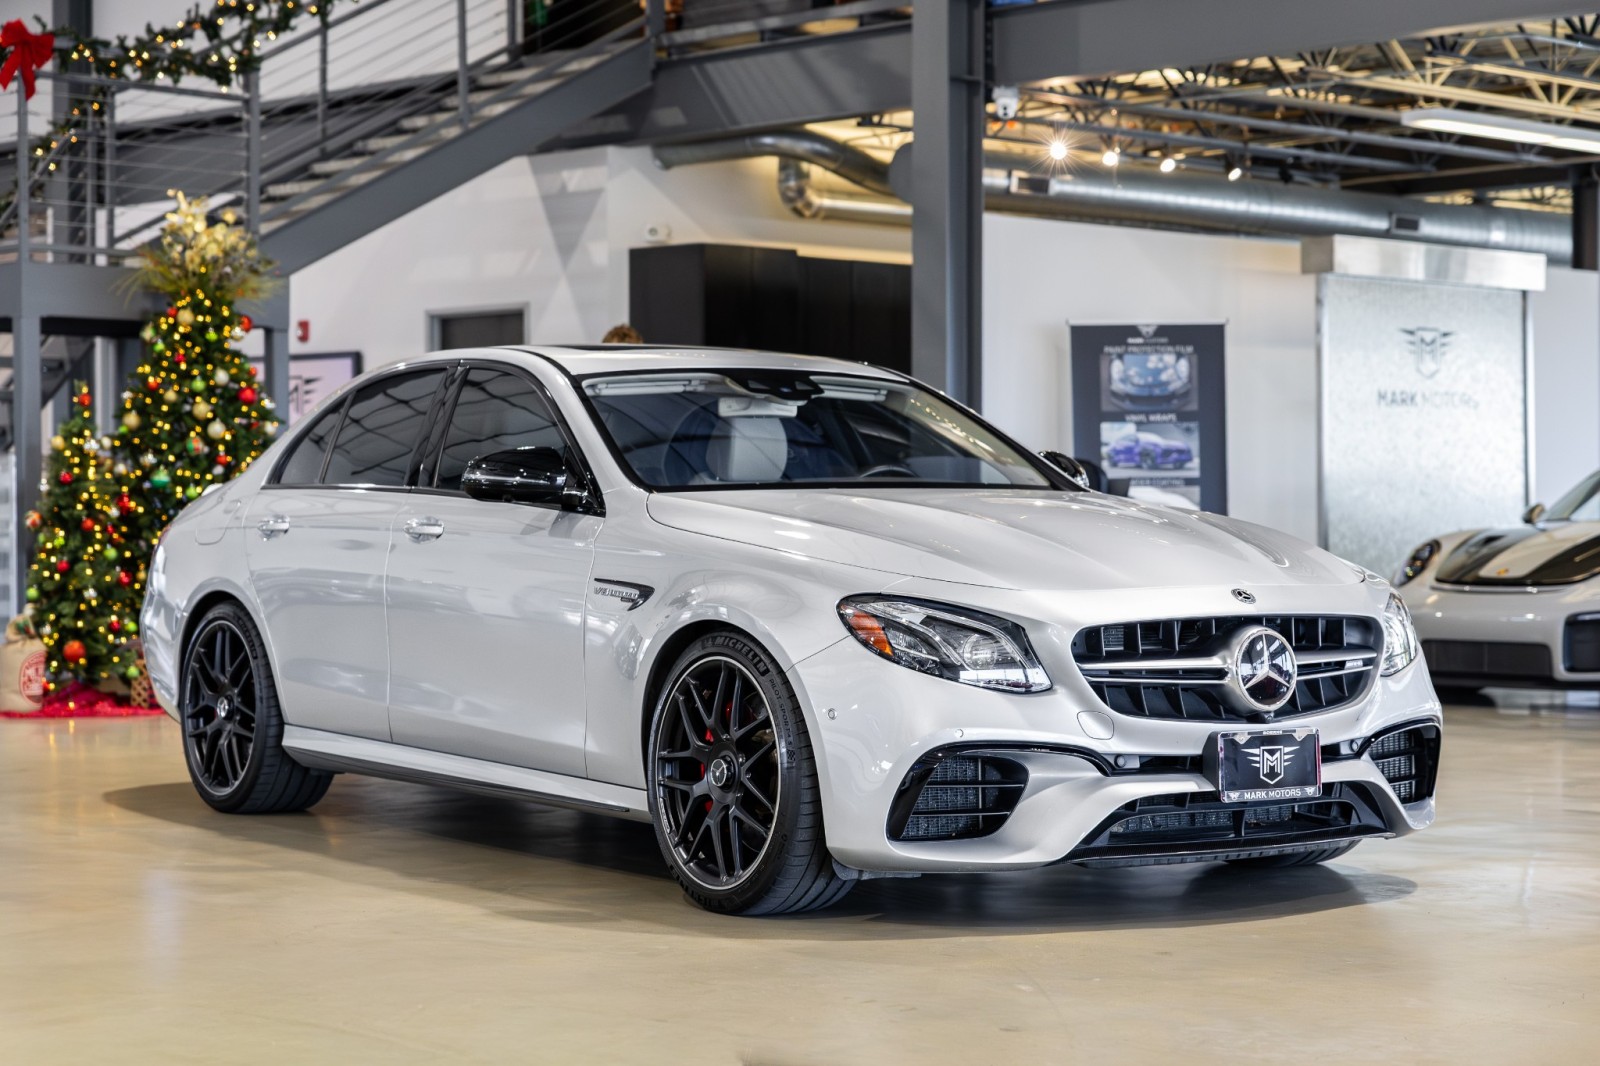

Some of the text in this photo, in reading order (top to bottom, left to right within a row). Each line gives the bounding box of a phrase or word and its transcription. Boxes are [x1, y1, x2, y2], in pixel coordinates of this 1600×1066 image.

[1377, 390, 1479, 410] MARK MOTORS
[1149, 413, 1177, 422] WRAPS
[714, 636, 767, 674] MICHELIN
[769, 679, 782, 700] PILOT
[780, 703, 791, 732] SPORT
[1244, 788, 1301, 799] MARK MOTORS
